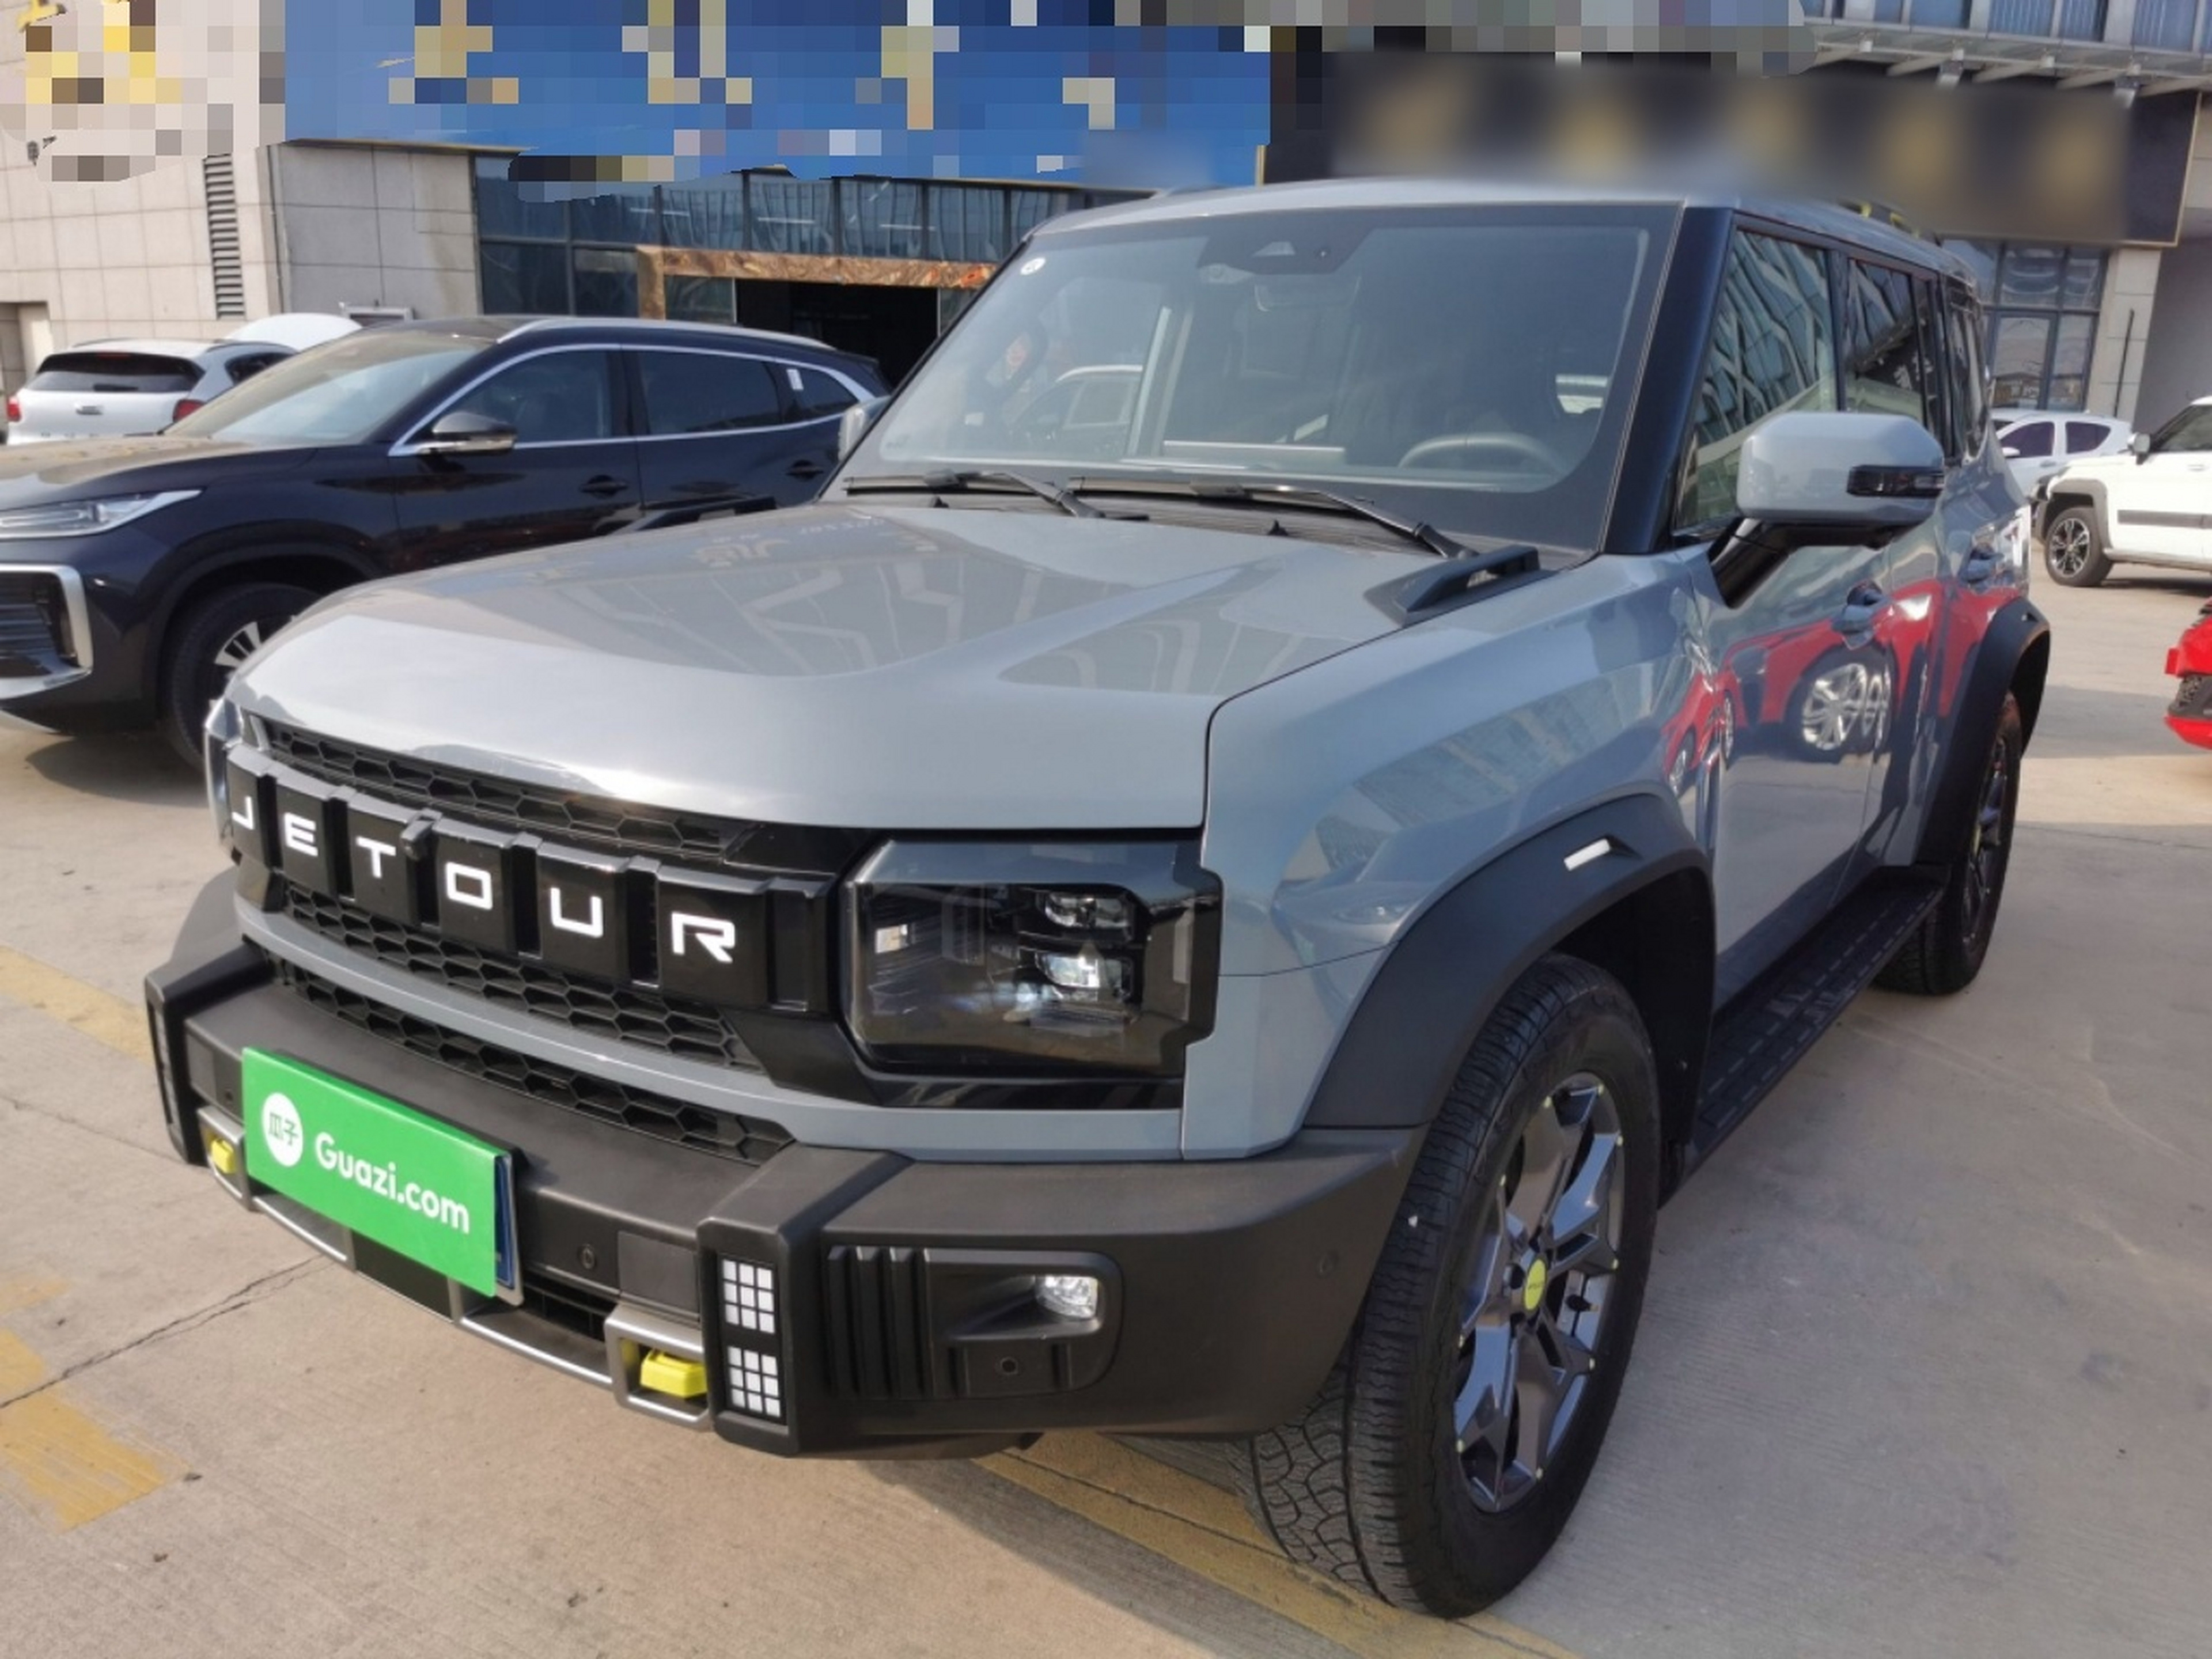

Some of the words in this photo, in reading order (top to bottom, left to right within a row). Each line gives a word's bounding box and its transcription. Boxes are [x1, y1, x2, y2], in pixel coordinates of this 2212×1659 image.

[232, 796, 736, 963] JETOUR
[268, 1112, 299, 1146] 瓜子
[315, 1131, 470, 1234] Guazi.com
